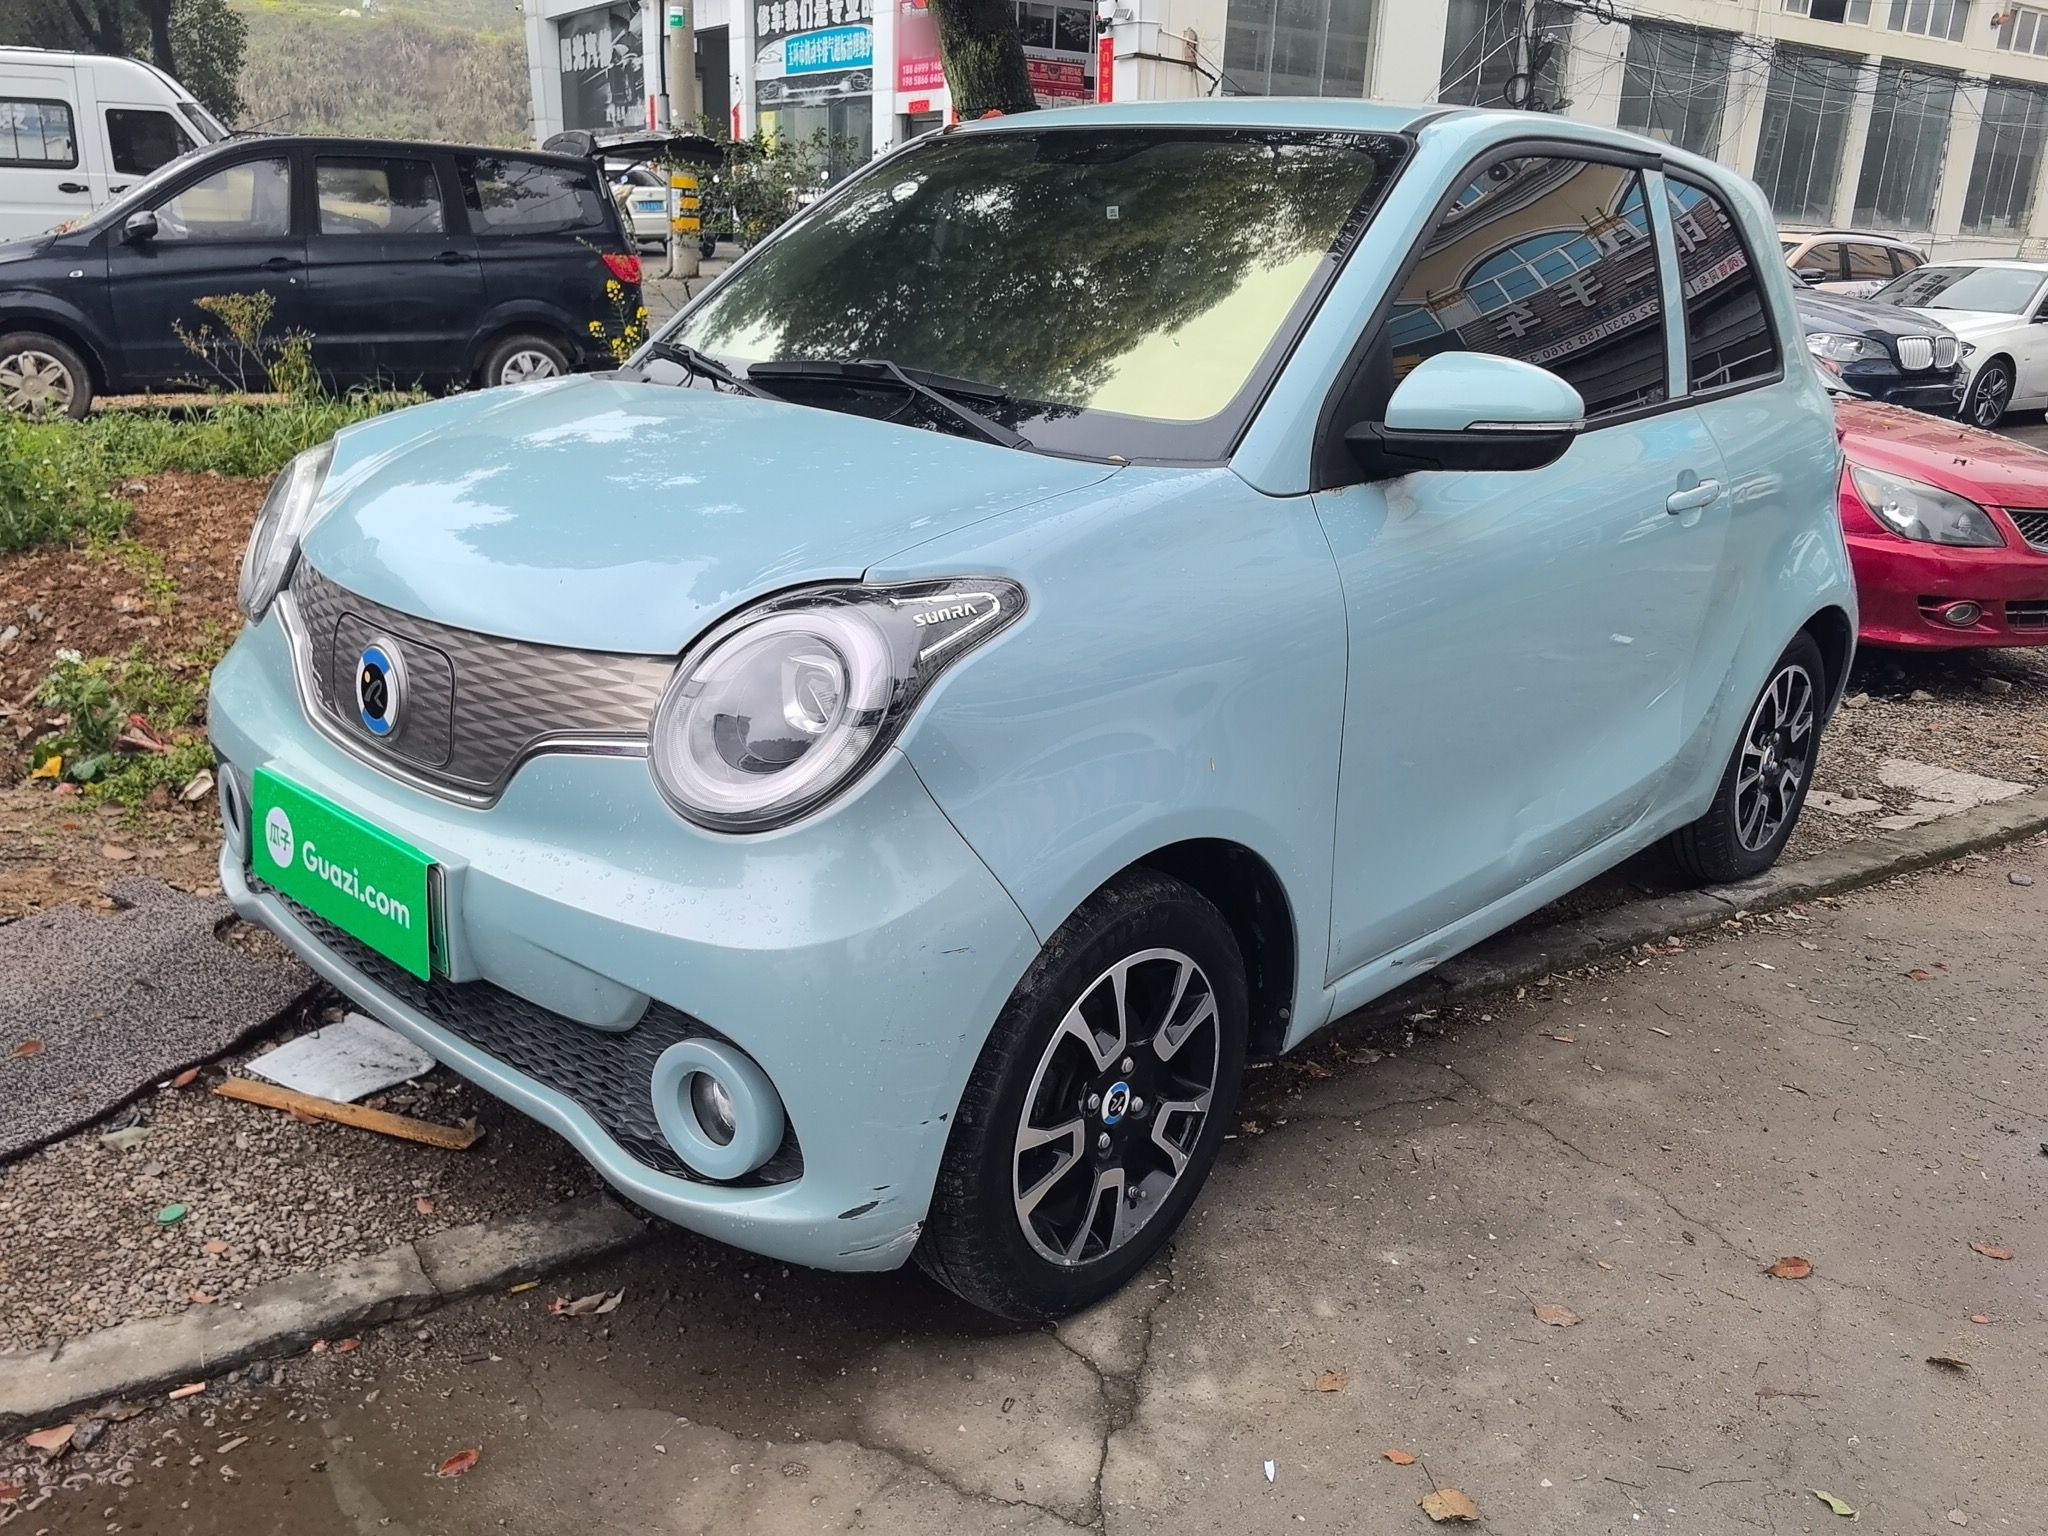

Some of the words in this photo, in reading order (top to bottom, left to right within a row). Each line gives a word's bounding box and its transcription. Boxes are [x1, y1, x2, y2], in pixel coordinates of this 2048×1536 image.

[913, 602, 978, 628] SUNRA
[269, 822, 291, 852] 瓜子
[302, 840, 410, 930] Guazi.com
